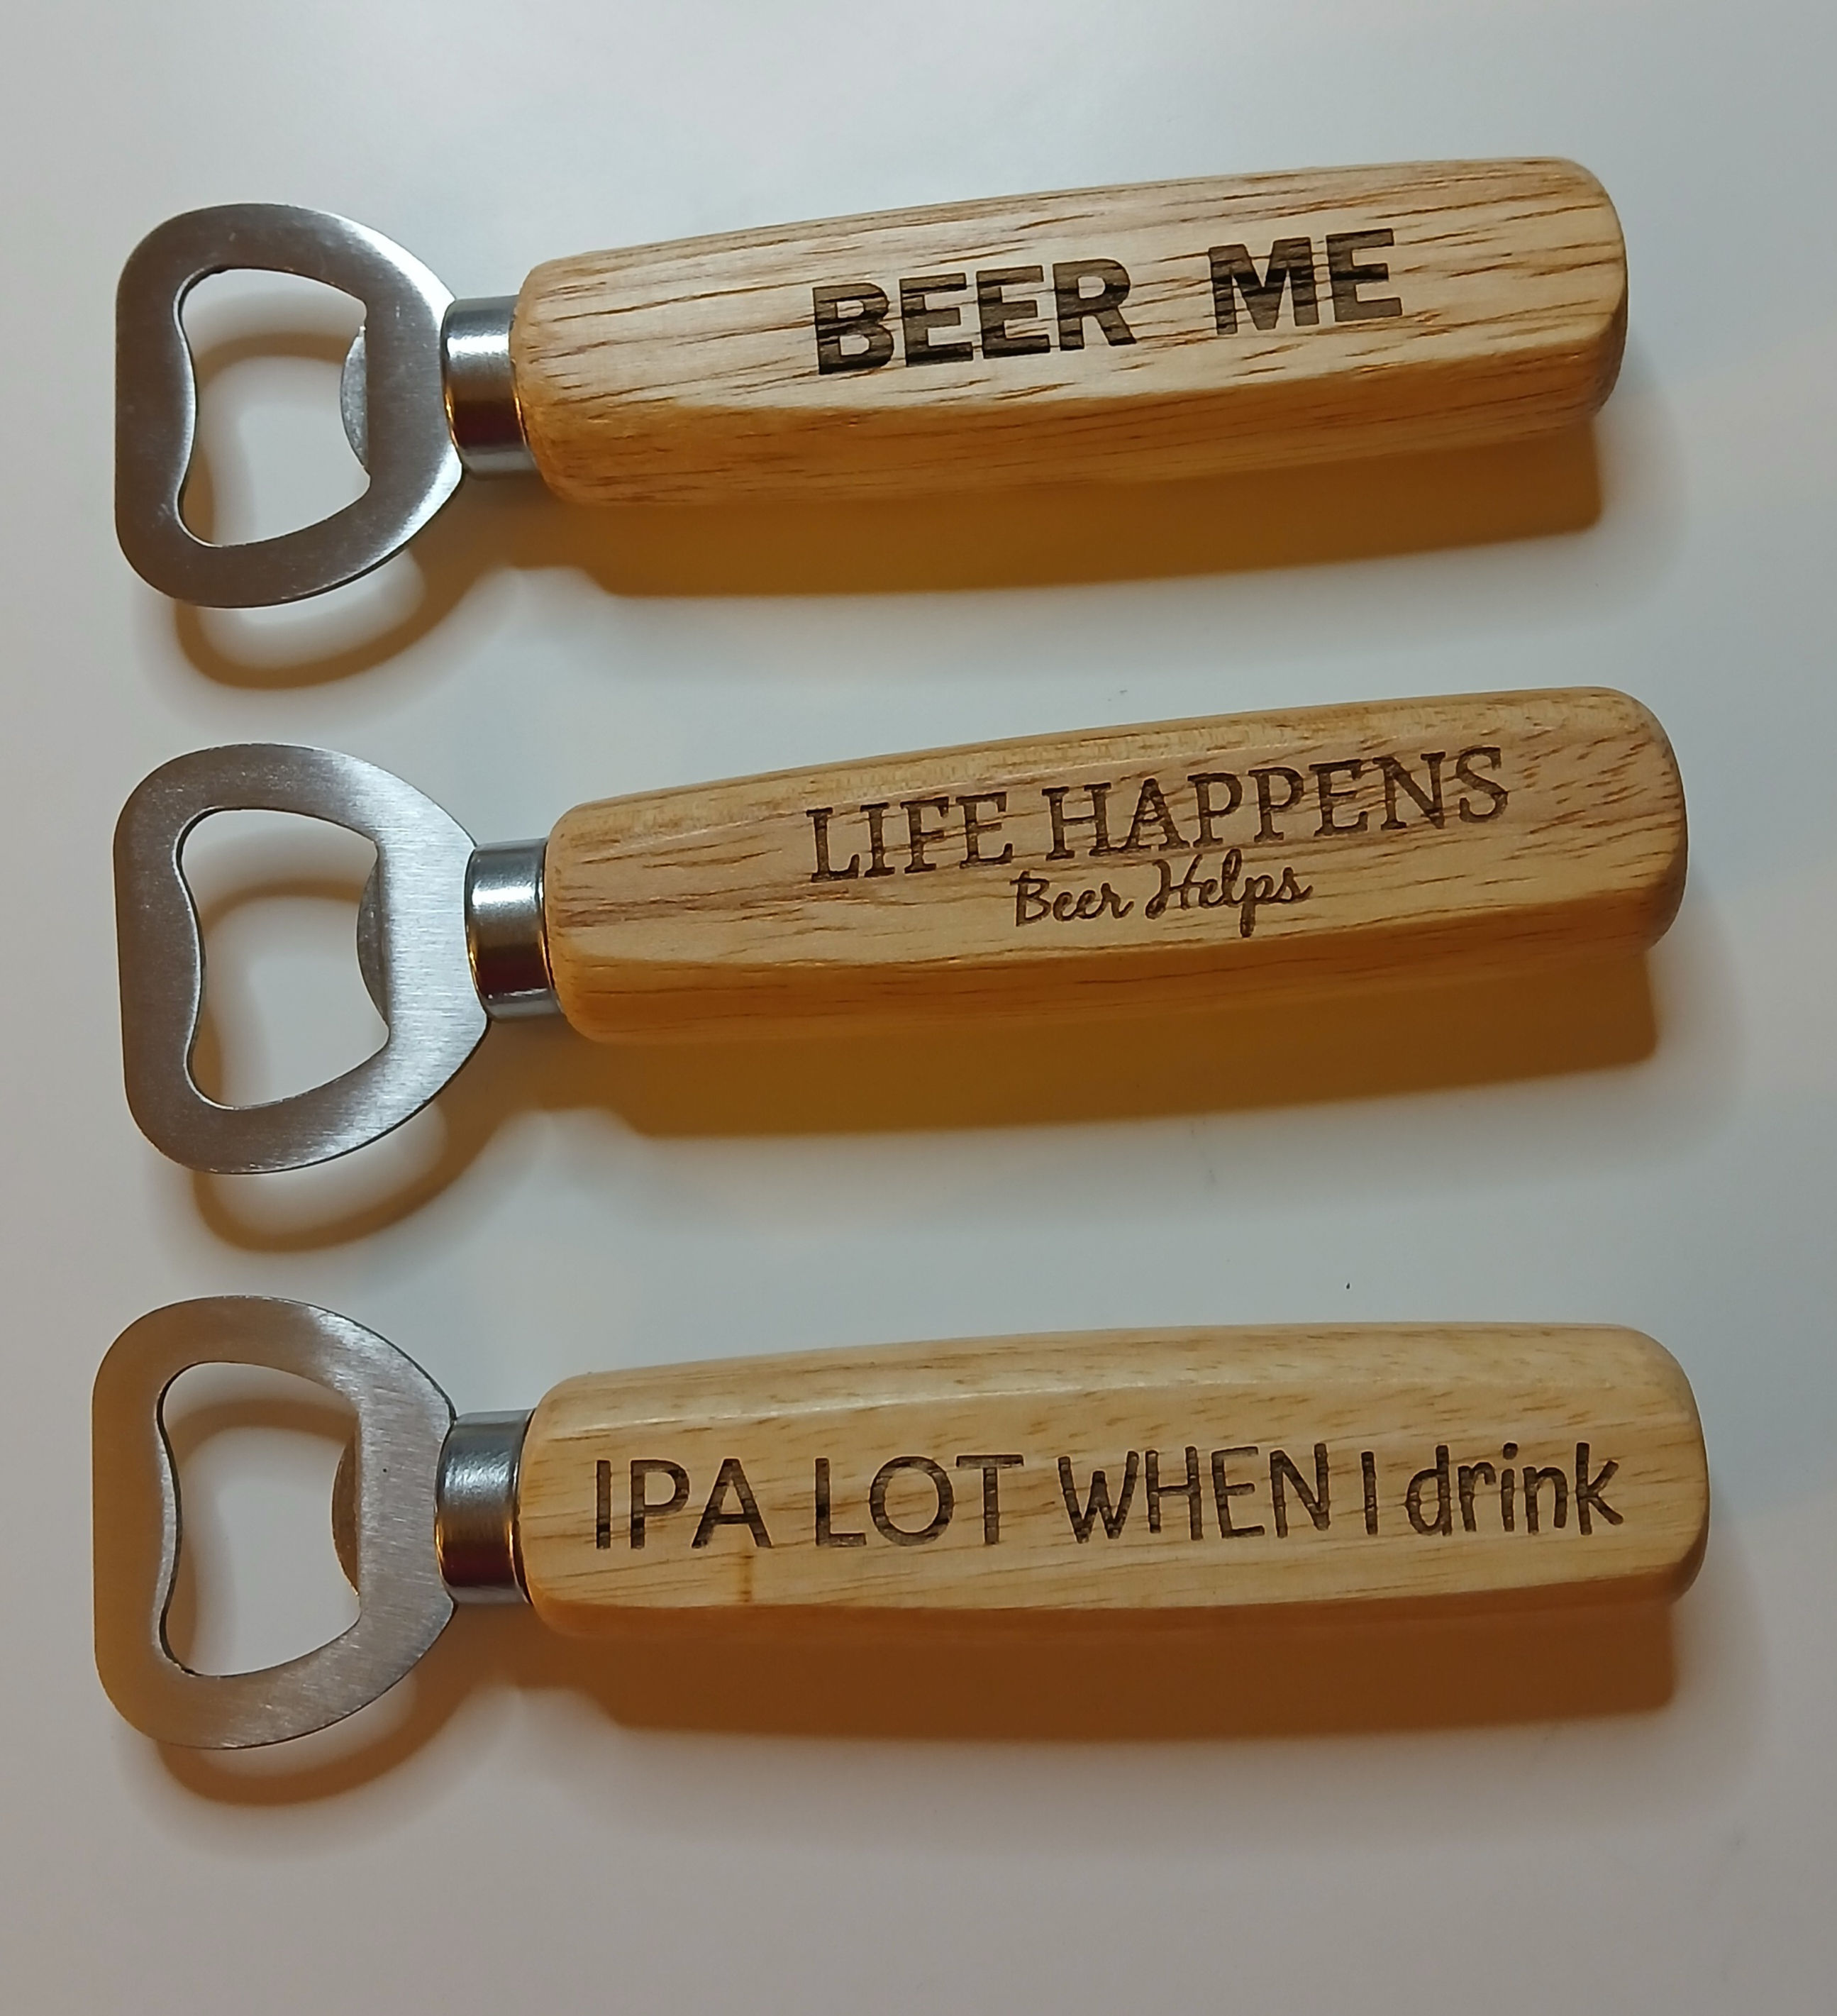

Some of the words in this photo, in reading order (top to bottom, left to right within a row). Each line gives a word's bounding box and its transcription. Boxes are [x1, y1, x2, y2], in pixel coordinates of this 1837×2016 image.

[812, 257, 1136, 375] BEER
[1208, 228, 1403, 336] ME
[805, 791, 1014, 884] LIFE
[1041, 746, 1510, 860] HAPPENS
[1010, 870, 1135, 927] Beer
[1145, 848, 1314, 938] Helps
[596, 1458, 774, 1549] IPA
[814, 1455, 1024, 1547] LOT
[1058, 1442, 1331, 1544] WHEN
[1360, 1451, 1379, 1536] I
[1404, 1441, 1625, 1537] drink
